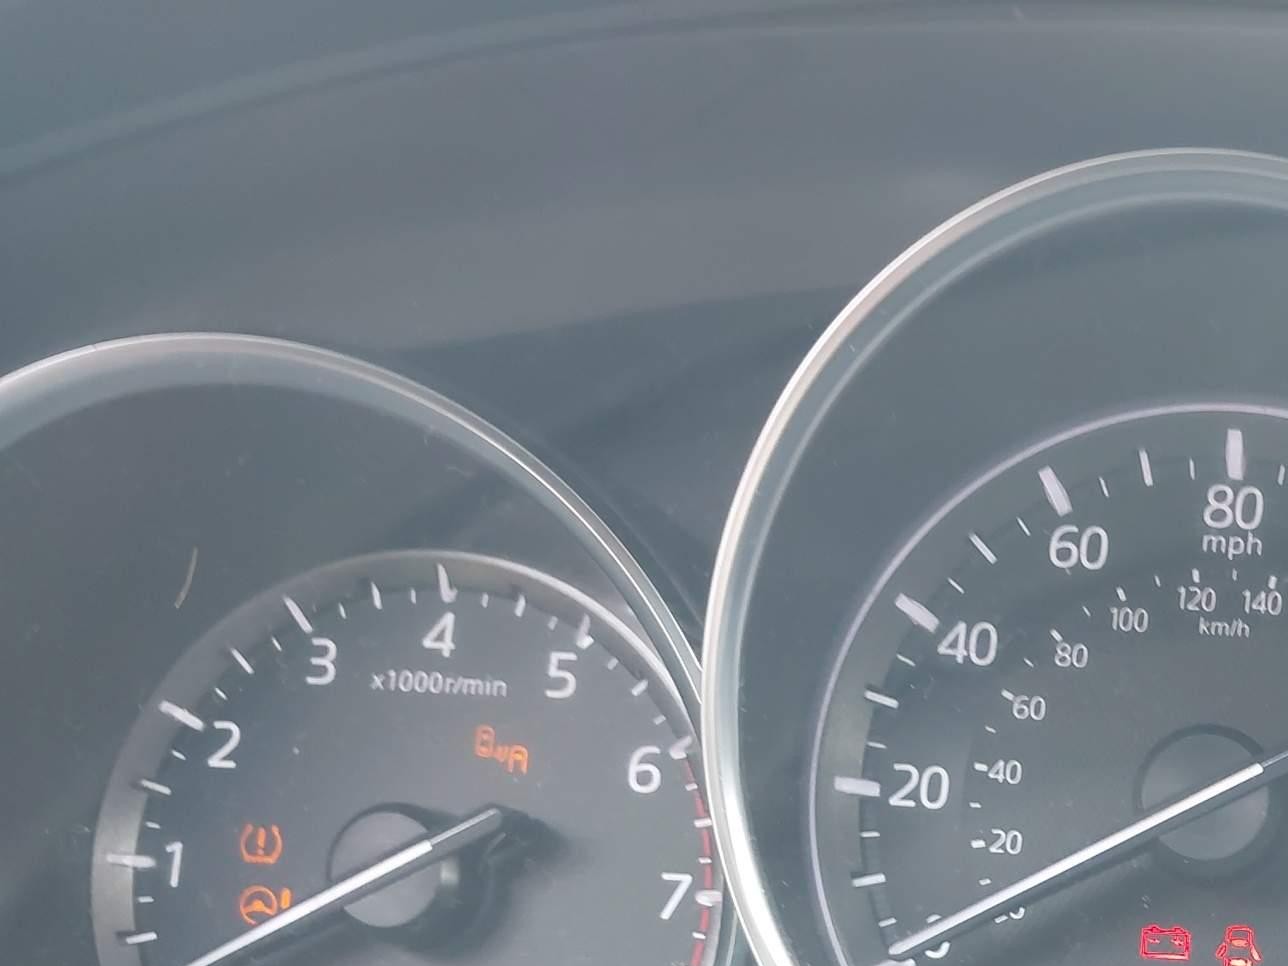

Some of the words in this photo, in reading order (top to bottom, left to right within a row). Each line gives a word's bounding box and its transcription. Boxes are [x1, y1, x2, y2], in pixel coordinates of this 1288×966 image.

[1204, 485, 1263, 532] 80
[1048, 525, 1109, 570] 60
[1202, 533, 1263, 560] mph
[1110, 606, 1148, 633] 100
[1177, 586, 1216, 613] 120
[1242, 589, 1282, 617] 140
[423, 612, 456, 657] 4
[938, 620, 997, 666] 40
[1198, 617, 1250, 640] km/h
[306, 639, 337, 685] 3
[545, 651, 578, 699] 5
[1054, 642, 1088, 669] 80
[370, 669, 508, 698] x1000r/min
[1011, 696, 1046, 722] 60
[207, 720, 242, 768] 2
[627, 746, 661, 793] 6
[889, 763, 950, 810] 20
[988, 760, 1022, 786] 40
[166, 841, 184, 887] 1
[990, 829, 1022, 855] 20
[660, 873, 692, 920] 7
